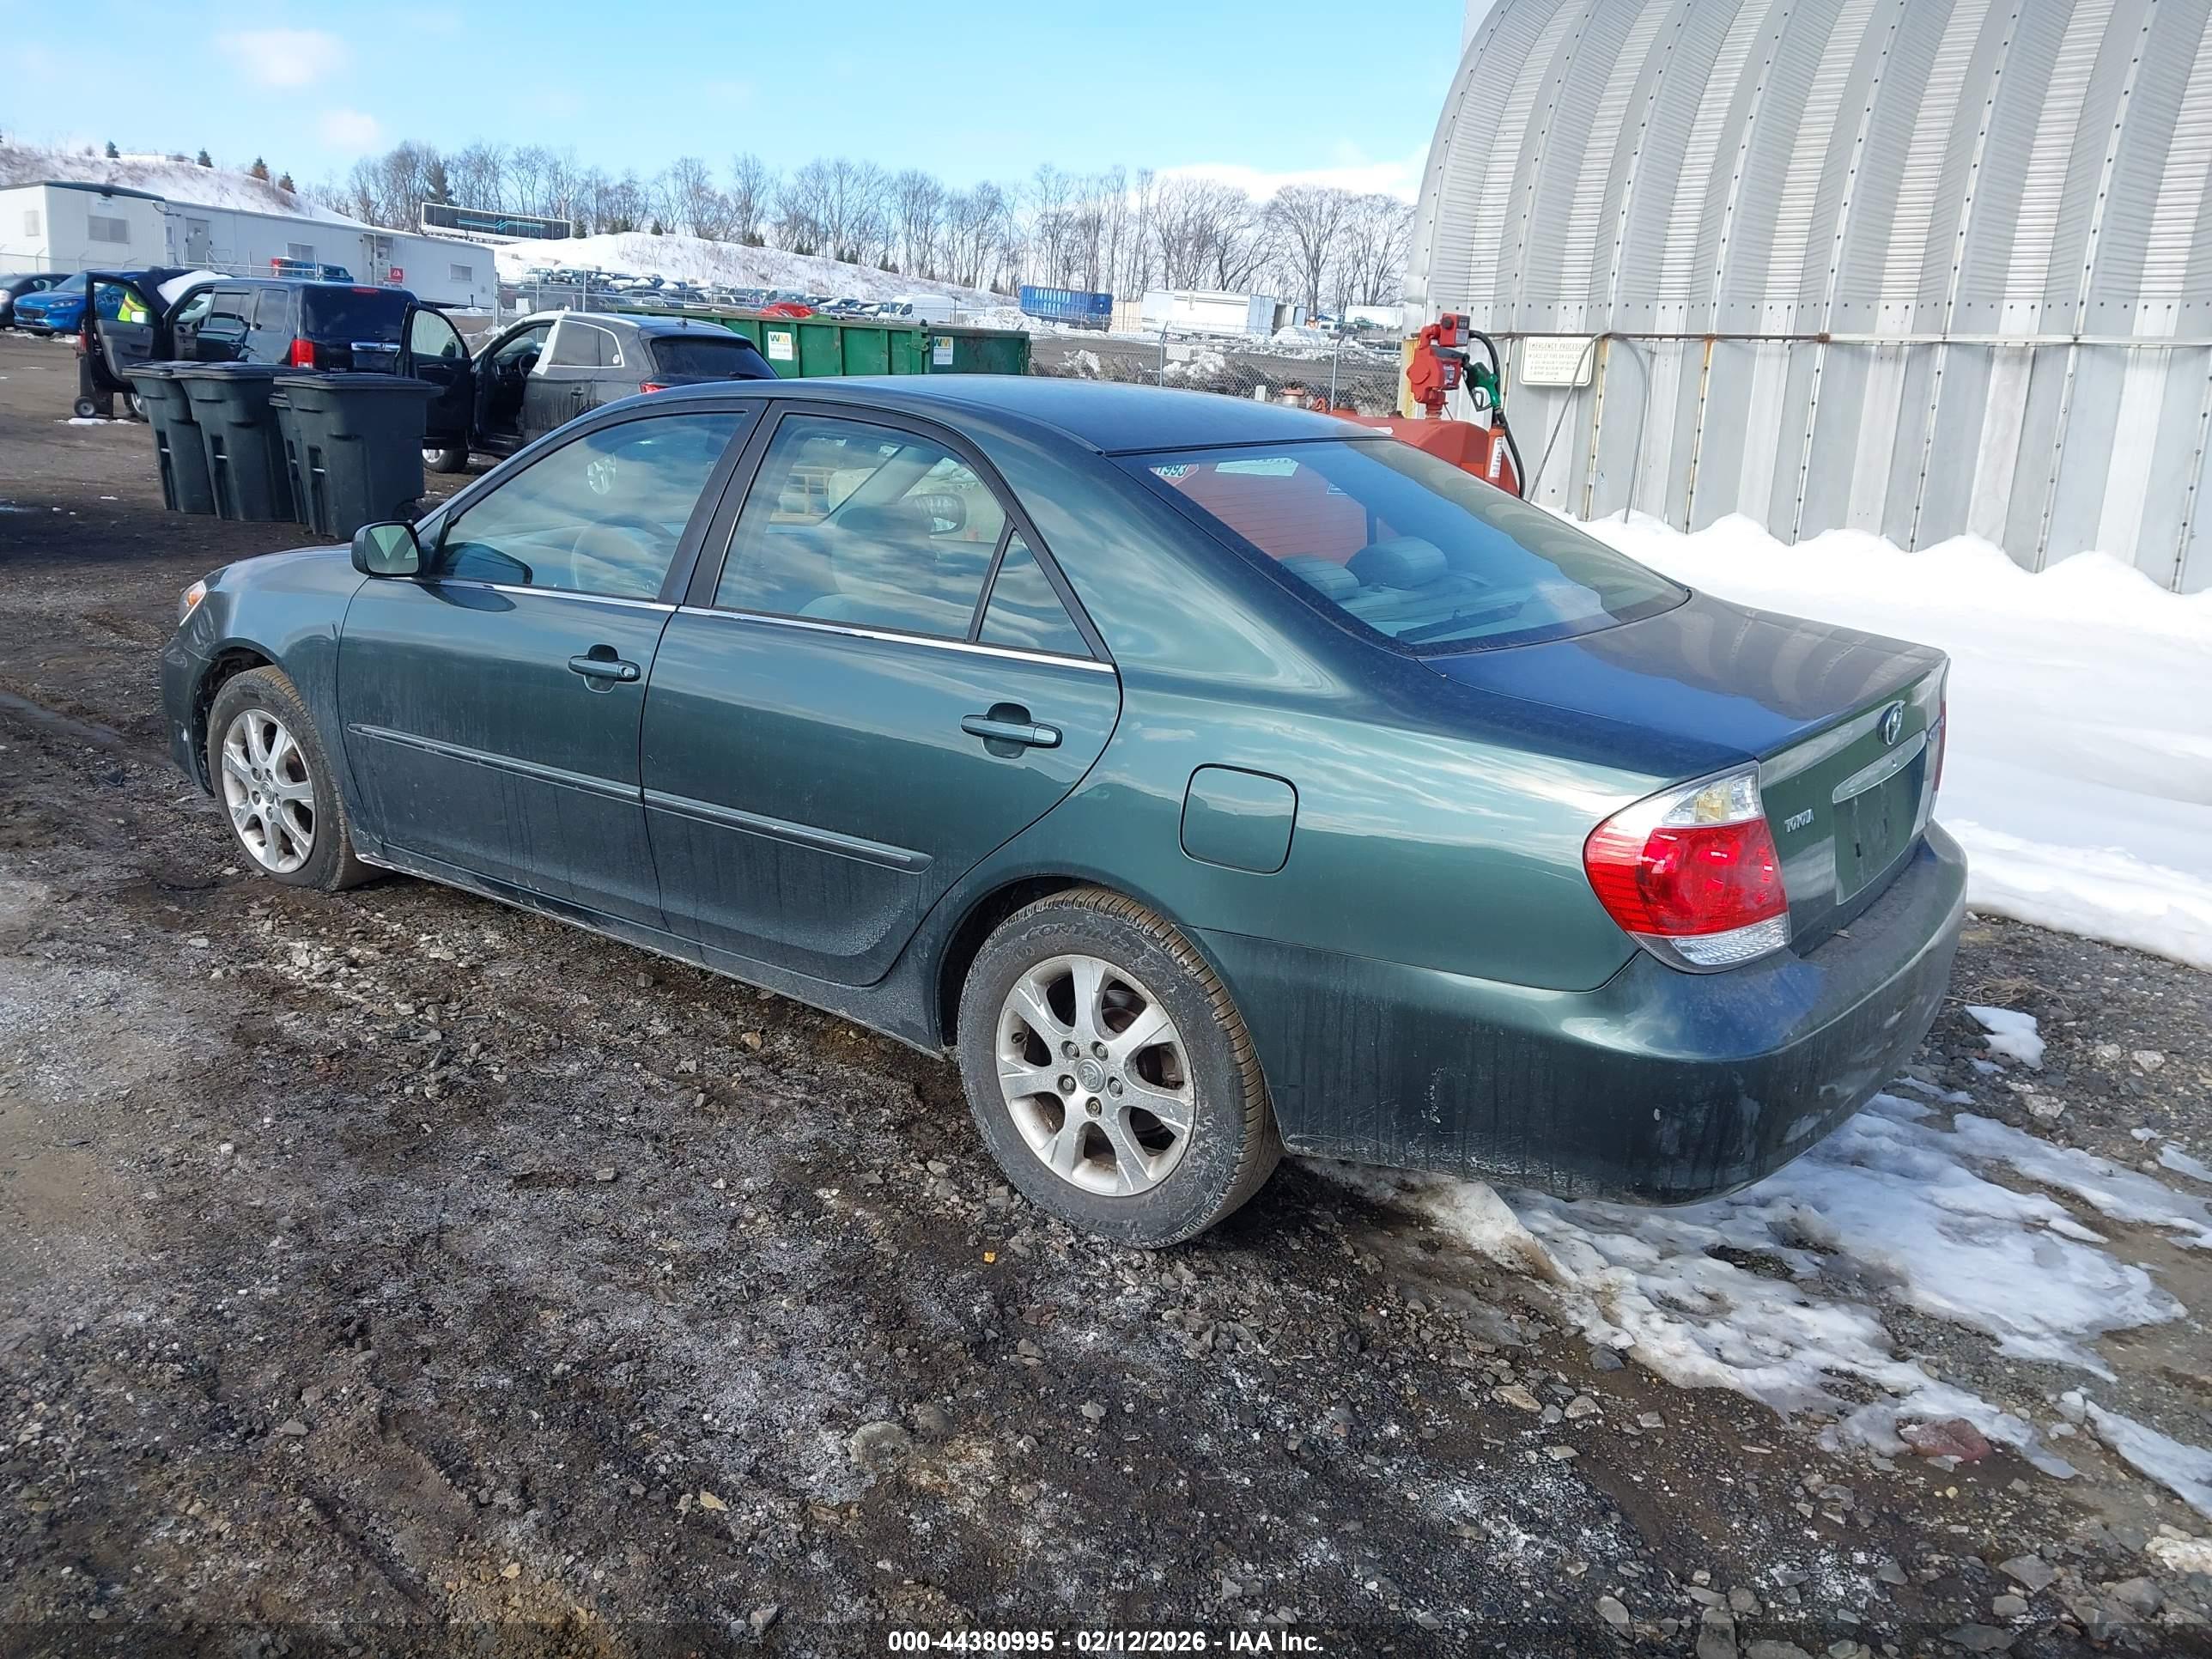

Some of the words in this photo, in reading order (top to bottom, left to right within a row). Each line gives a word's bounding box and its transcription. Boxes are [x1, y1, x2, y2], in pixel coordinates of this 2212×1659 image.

[769, 334, 789, 343] WM
[1528, 342, 1557, 350] EMERGENCY
[1784, 809, 1814, 833] TOYOTA
